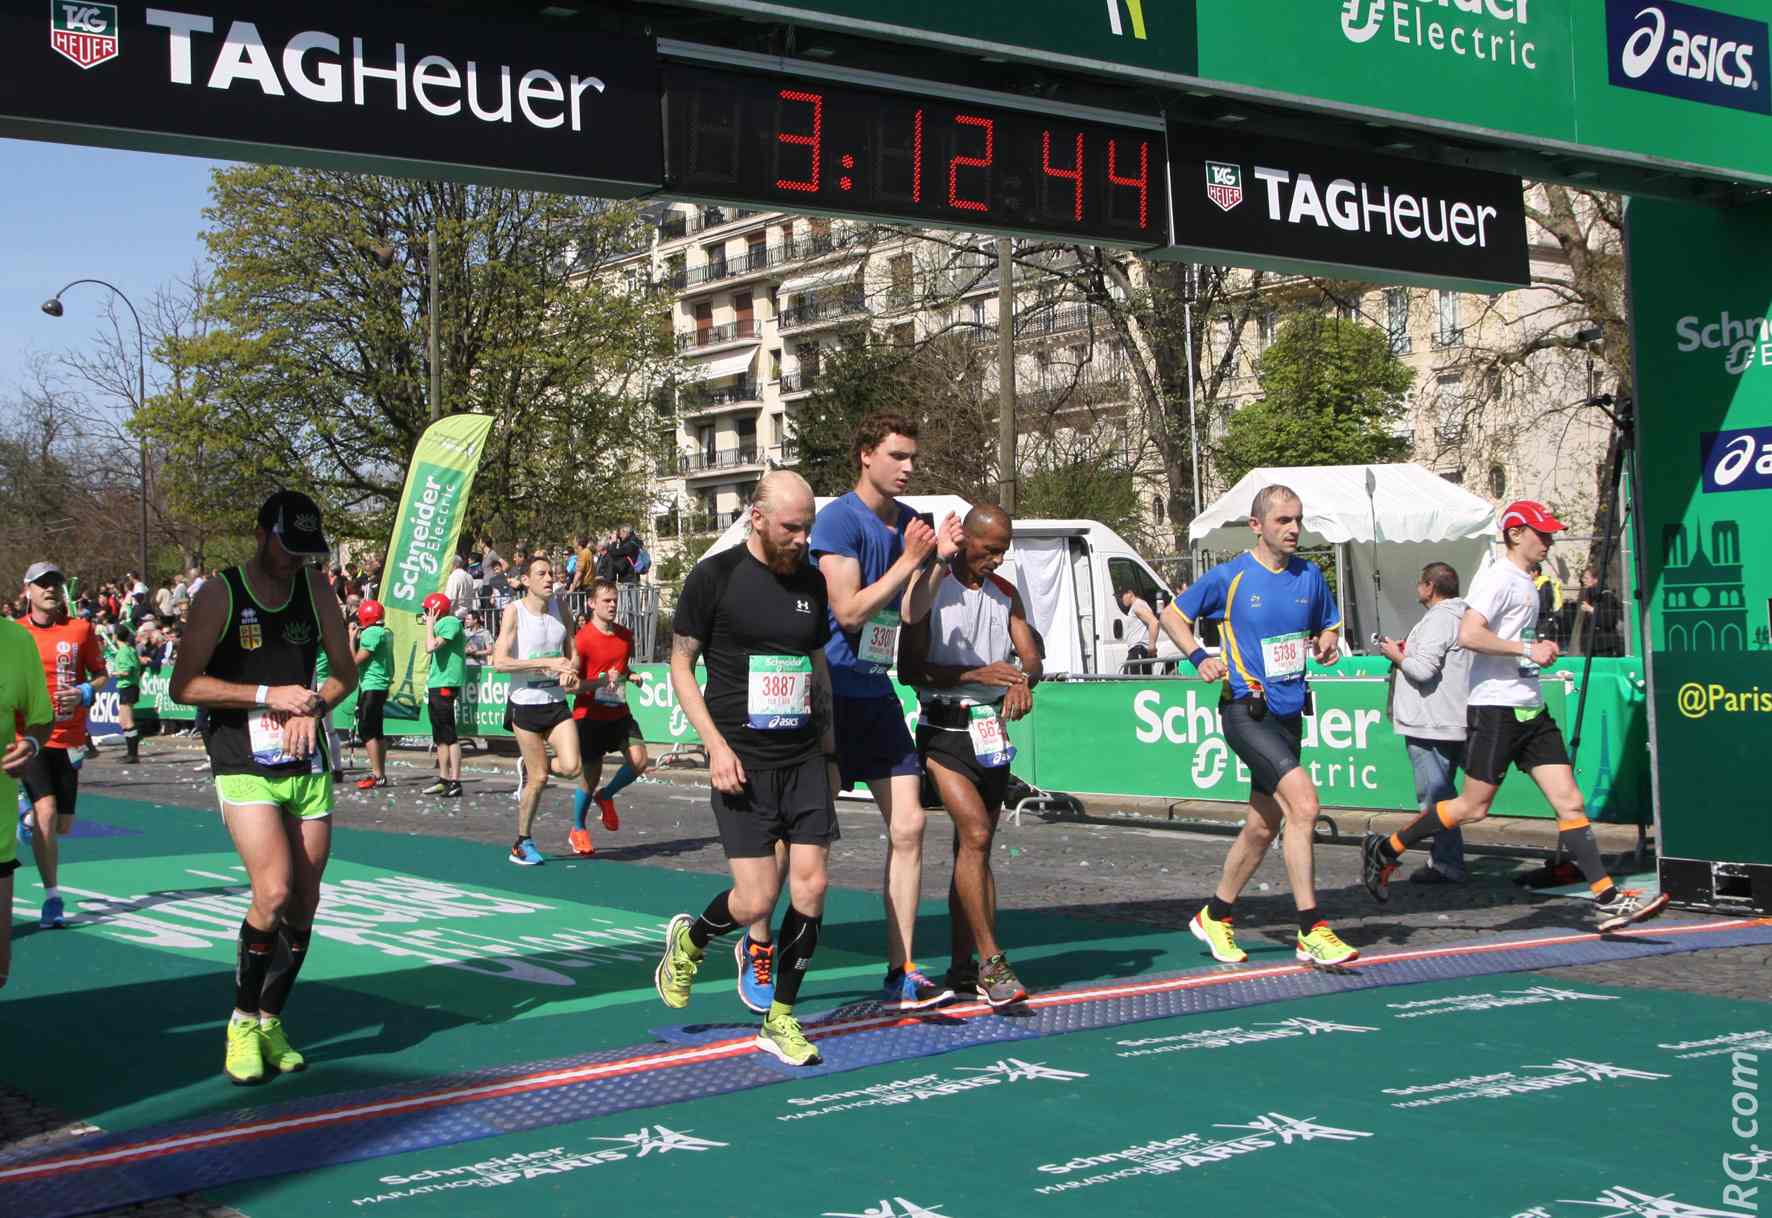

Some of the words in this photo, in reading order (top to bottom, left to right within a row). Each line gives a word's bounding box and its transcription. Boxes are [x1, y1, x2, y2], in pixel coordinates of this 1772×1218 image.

[62, 5, 107, 33] TAG
[1394, 1, 1537, 69] Electric
[57, 33, 113, 63] HEUER
[1666, 29, 1754, 89] asics
[1211, 166, 1236, 185] TAG
[1210, 186, 1240, 208] HEUER
[1676, 311, 1772, 352] Schn
[427, 485, 456, 552] Electric
[393, 475, 441, 601] Schneider
[762, 675, 796, 697] 3887
[1678, 683, 1772, 718] @Paris
[1235, 751, 1378, 789] Etric
